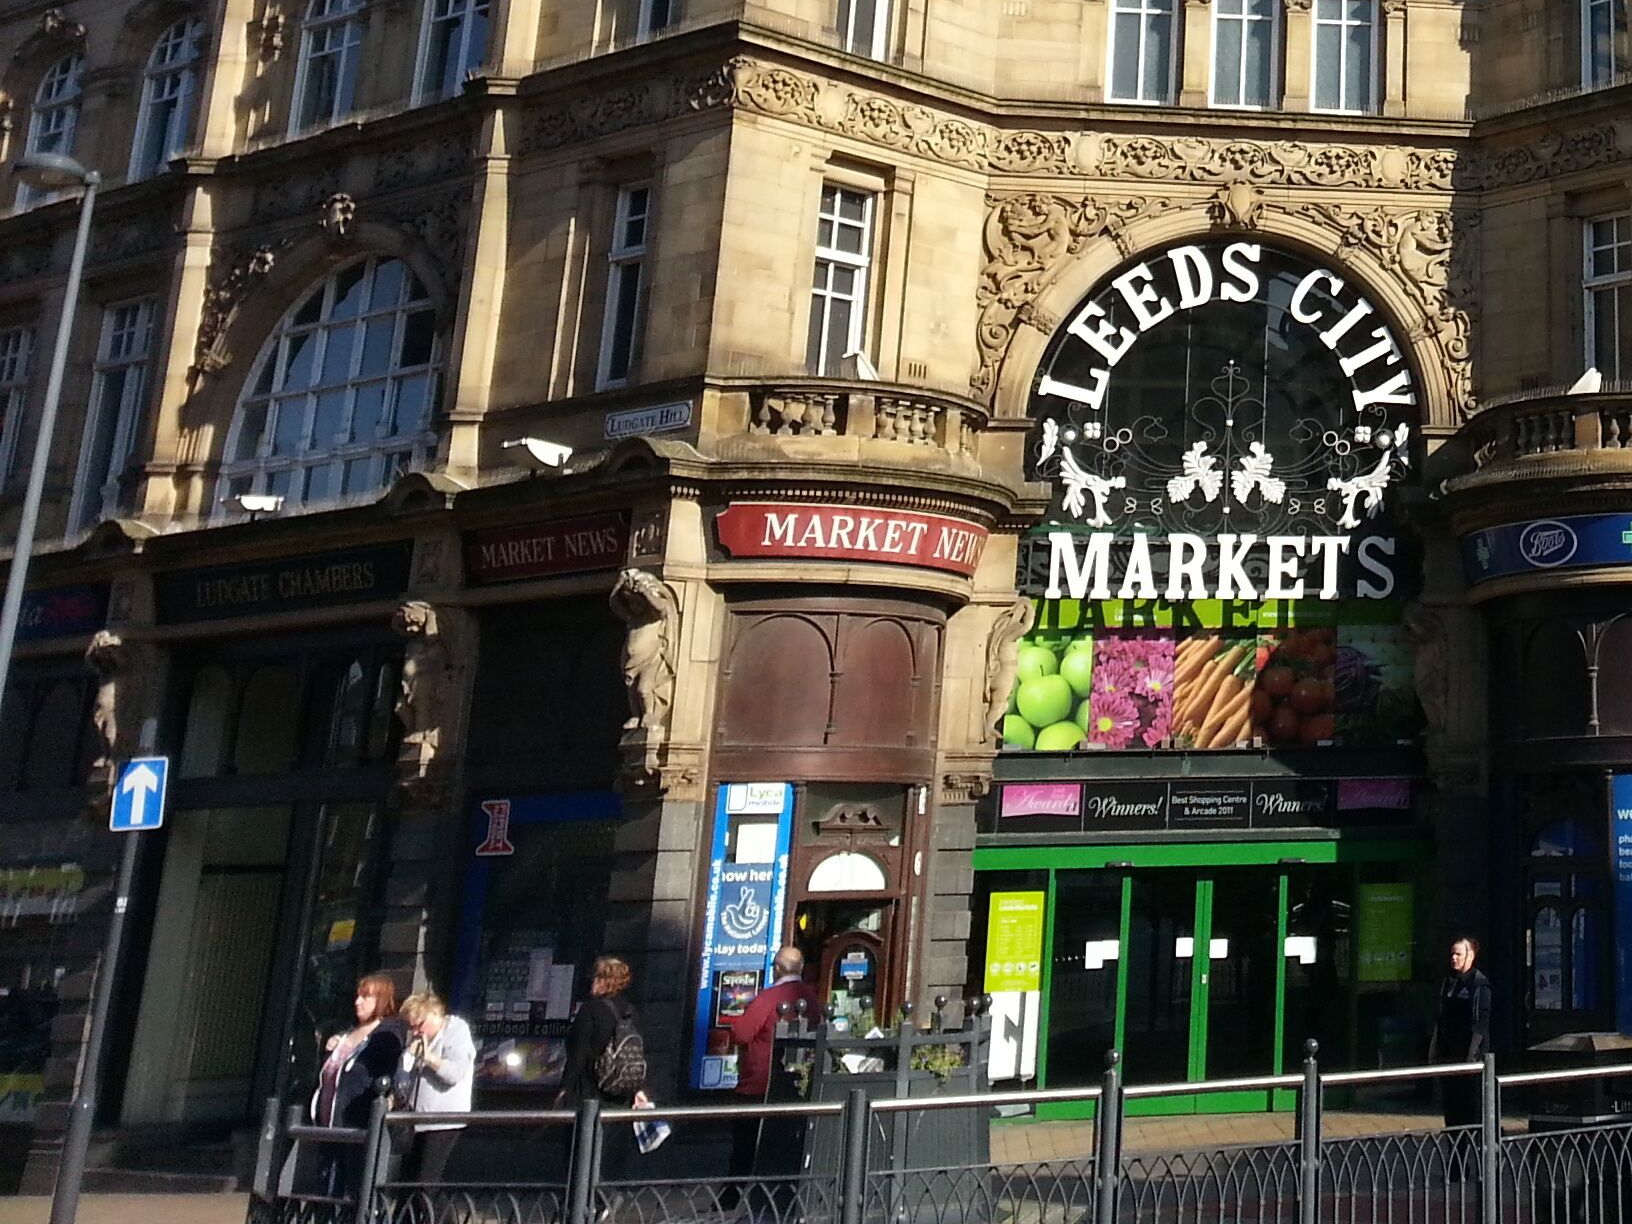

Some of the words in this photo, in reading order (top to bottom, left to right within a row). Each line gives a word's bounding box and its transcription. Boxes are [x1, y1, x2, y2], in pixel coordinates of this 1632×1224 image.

[1037, 242, 1261, 409] LEEDS
[1290, 268, 1417, 412] CITY
[480, 534, 554, 569] MARKET
[564, 528, 618, 559] NEWS
[761, 513, 928, 555] MARKET
[933, 525, 986, 568] NEWS
[1528, 528, 1569, 558] Boots
[1045, 532, 1396, 600] MARKETS
[1088, 795, 1163, 819] Winners!
[1171, 795, 1188, 804] Best
[1189, 795, 1222, 806] Shopping
[1223, 795, 1248, 804] Centre
[714, 943, 735, 956] lay
